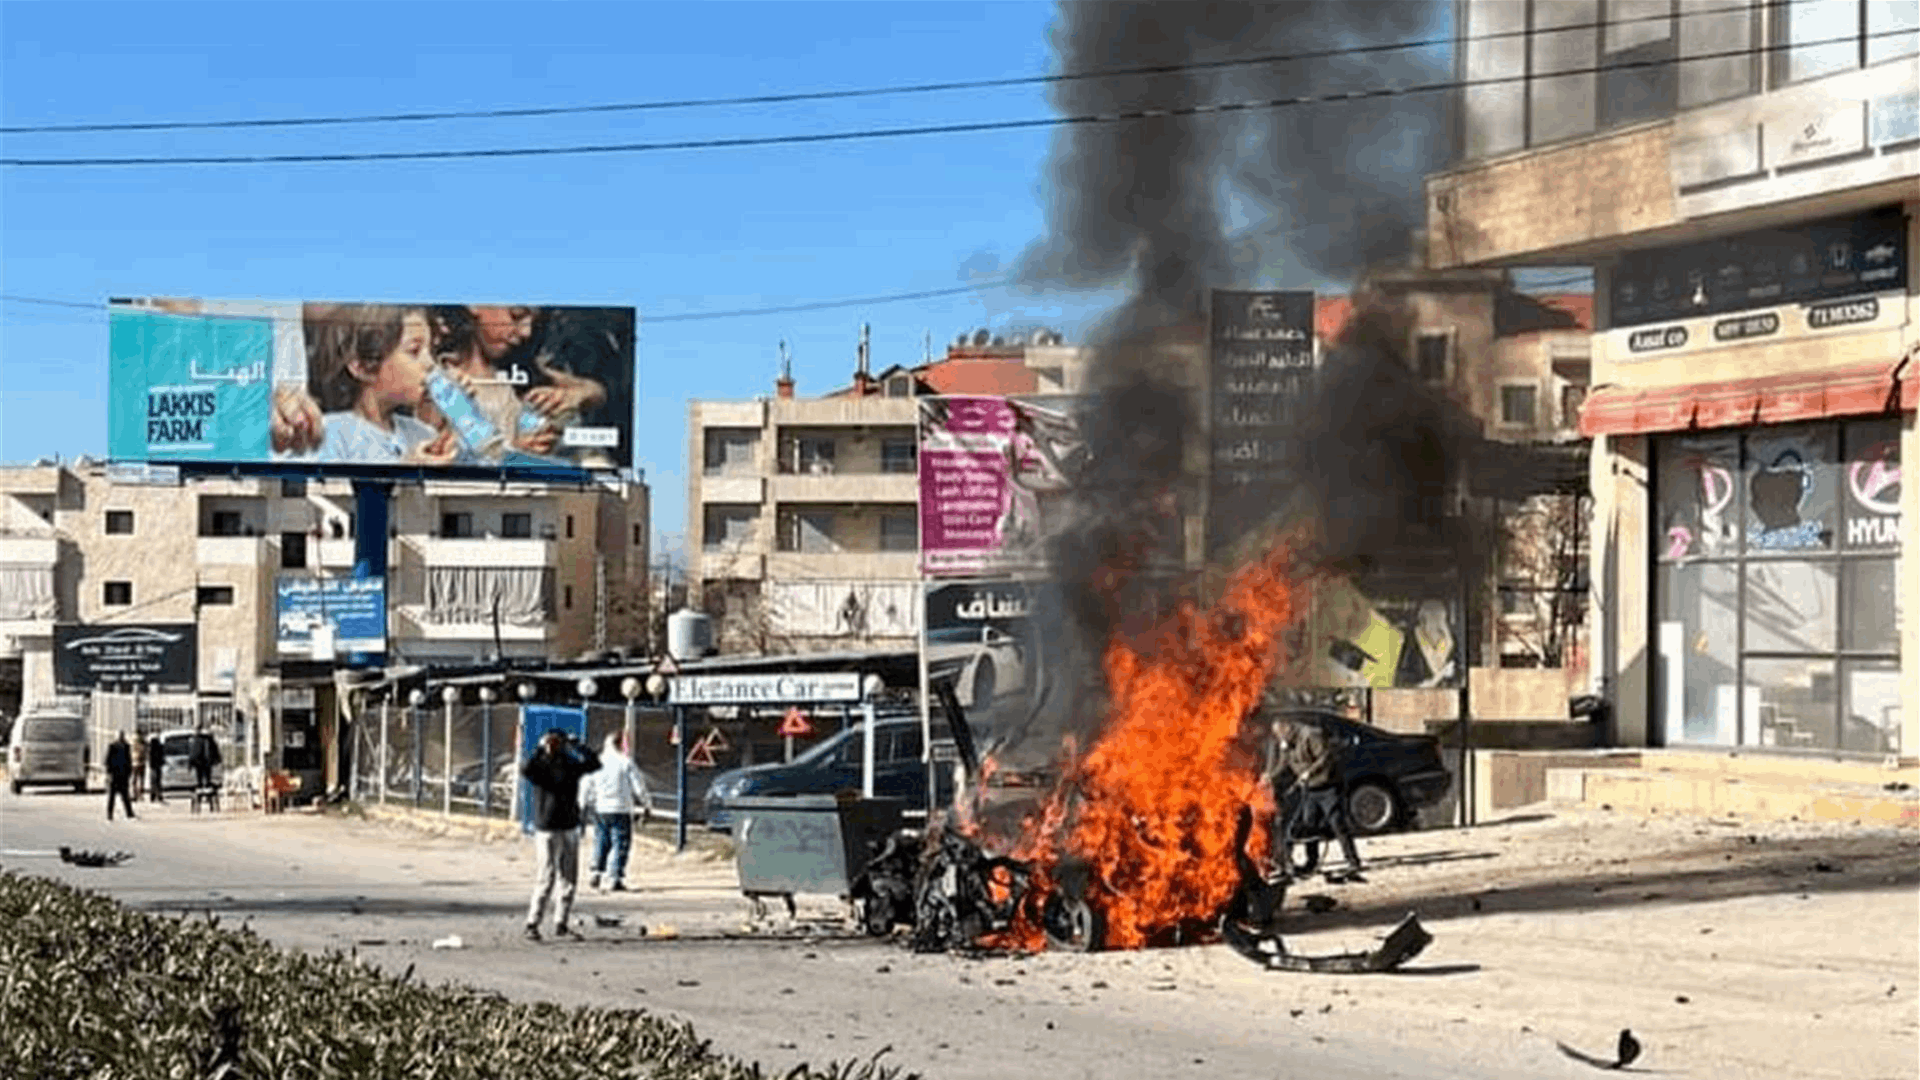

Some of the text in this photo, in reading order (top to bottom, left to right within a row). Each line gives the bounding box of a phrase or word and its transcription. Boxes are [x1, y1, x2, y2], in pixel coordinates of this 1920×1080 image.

[148, 392, 216, 418] LAKKIS
[147, 419, 203, 443] FARM
[776, 674, 820, 699] Car
